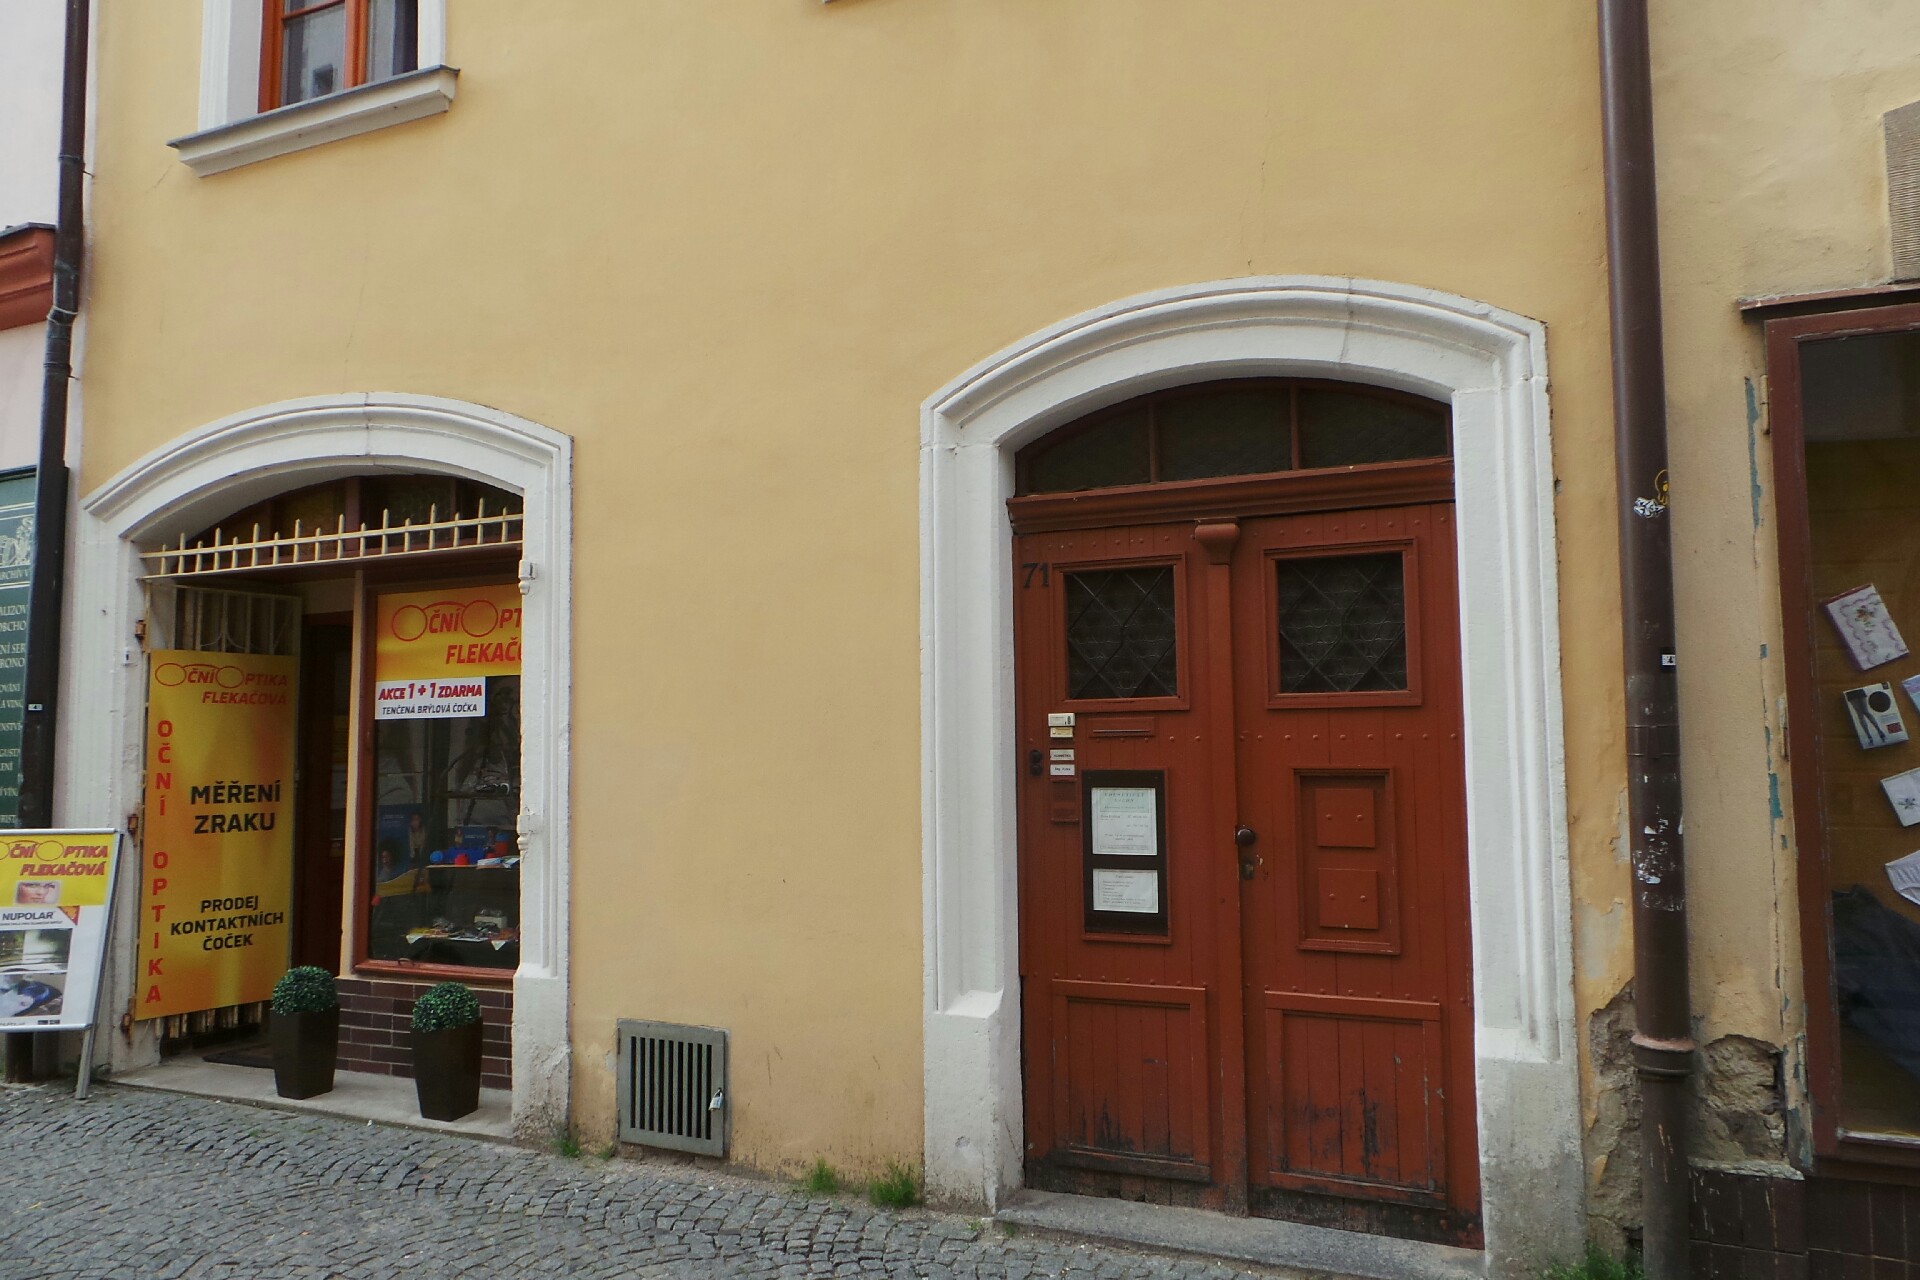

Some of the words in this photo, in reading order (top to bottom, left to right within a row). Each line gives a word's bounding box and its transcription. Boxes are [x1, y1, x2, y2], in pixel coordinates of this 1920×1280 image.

[1021, 561, 1050, 589] 71
[445, 636, 522, 665] FLEKAČ
[202, 689, 289, 705] FLEKAČOVÁ
[377, 687, 406, 701] AKCE
[437, 684, 483, 699] ZDARMA
[381, 704, 415, 715] TENČENÁ
[416, 703, 451, 714] BRÝLOVÁ
[452, 702, 478, 713] ČOČKA
[190, 779, 282, 806] MĚŘENÍ
[193, 812, 276, 835] ZRAKU
[20, 861, 107, 877] FLEKAČOVÁ
[200, 895, 260, 914] PRODEJ
[2, 911, 54, 921] NUPOLAR
[170, 911, 284, 937] KONTAKTNÍCH
[146, 851, 169, 1004] OPTIKA
[202, 933, 254, 952] ČOČEK
